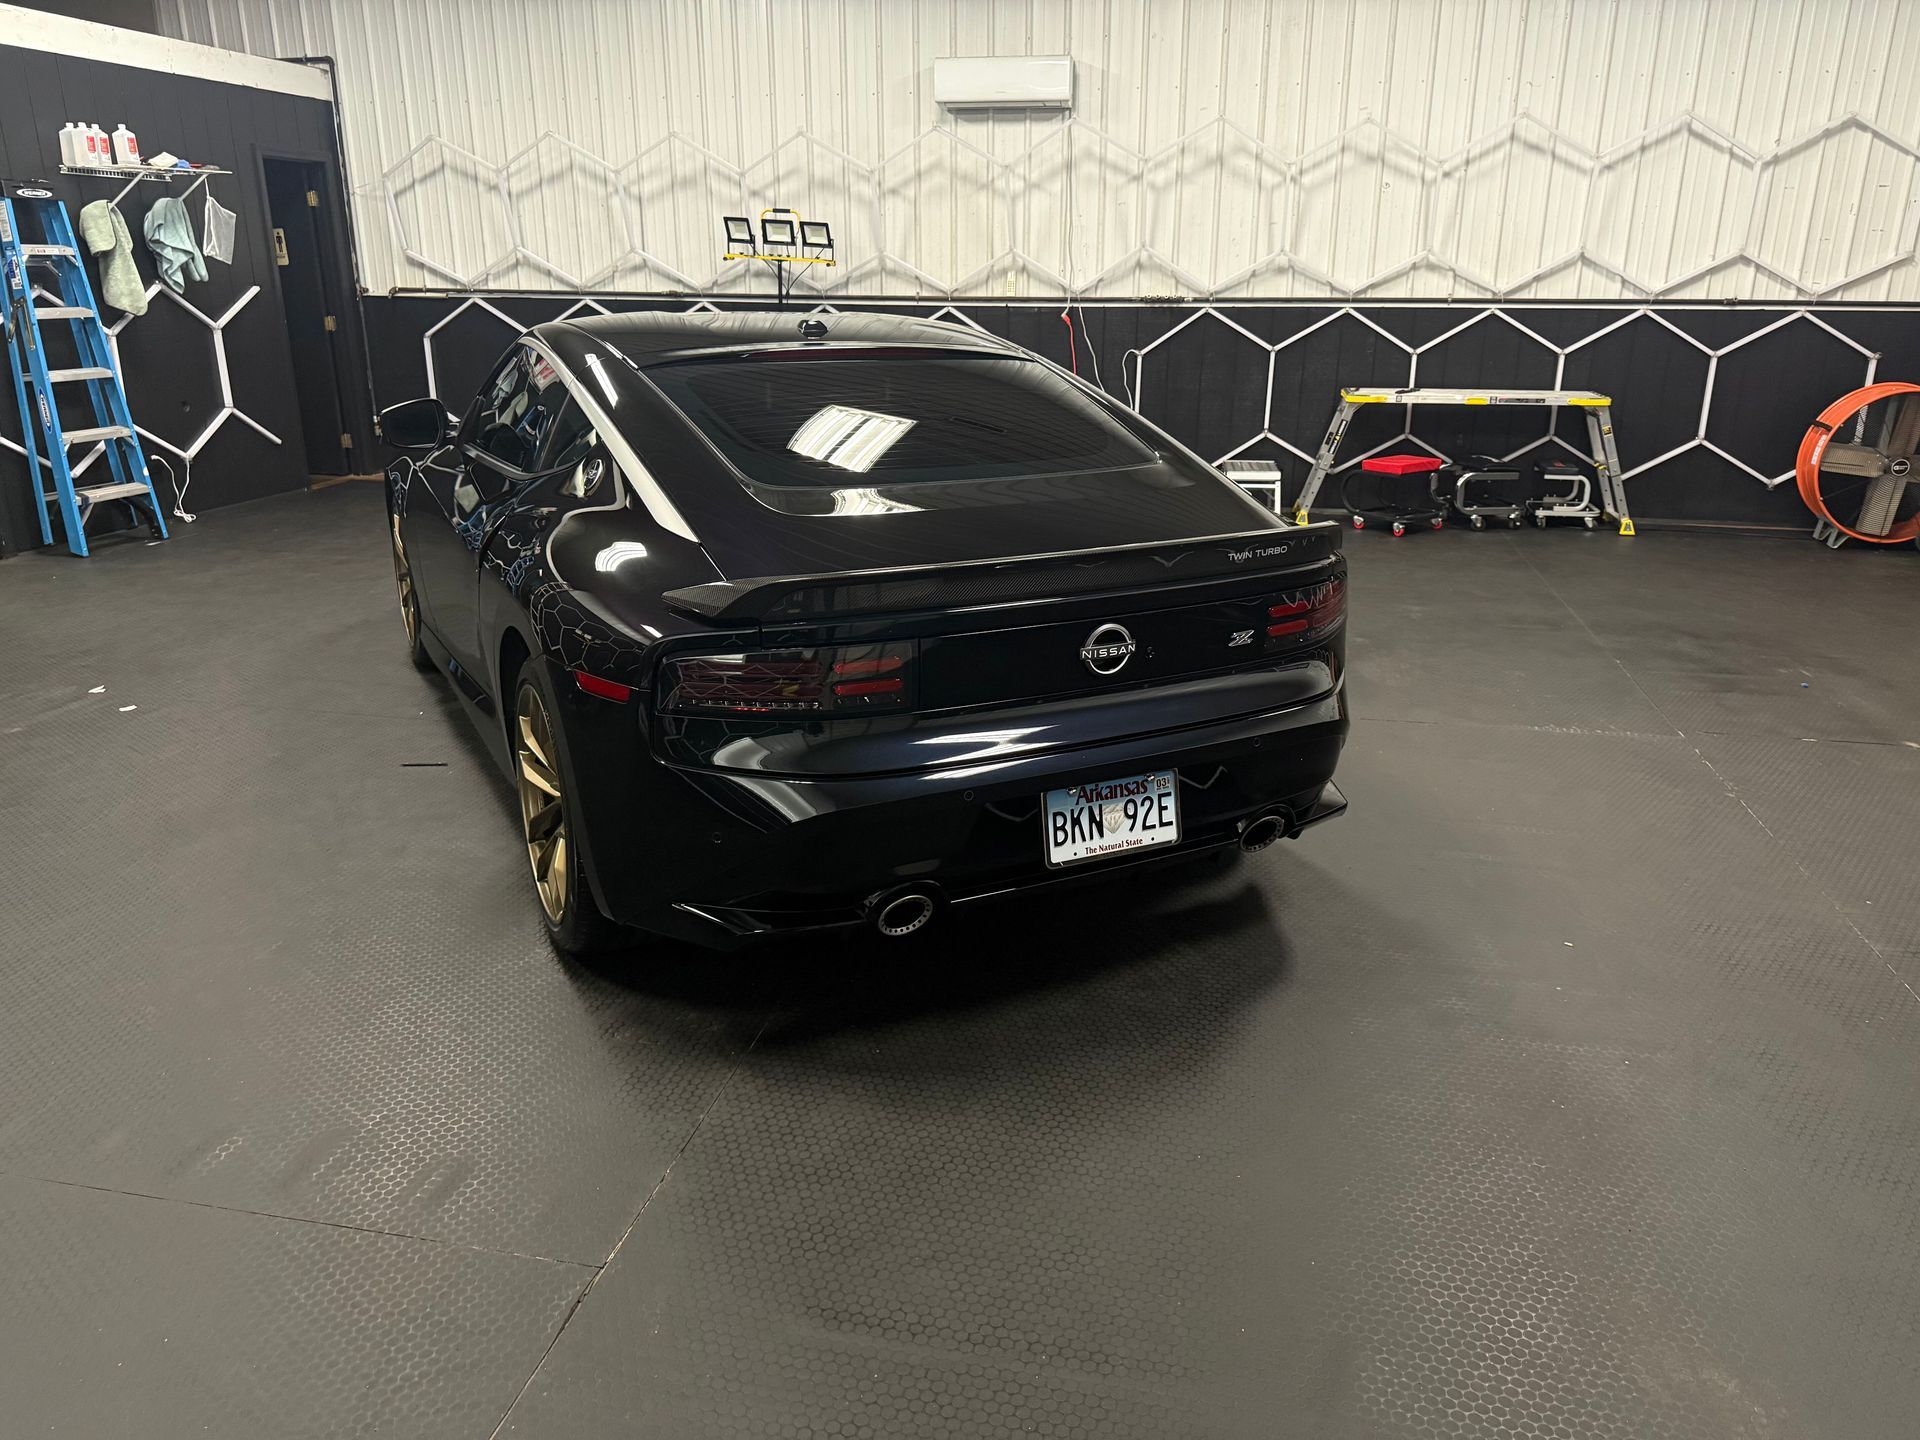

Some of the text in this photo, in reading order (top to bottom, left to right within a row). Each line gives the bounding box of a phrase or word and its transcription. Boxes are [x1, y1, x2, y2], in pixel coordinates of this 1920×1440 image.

[1228, 545, 1288, 561] TWIN TURBO
[1082, 643, 1136, 659] NISSAN
[1075, 780, 1148, 805] Arkansas
[1052, 792, 1173, 847] BKN 92E
[1085, 838, 1143, 855] The Natural State
